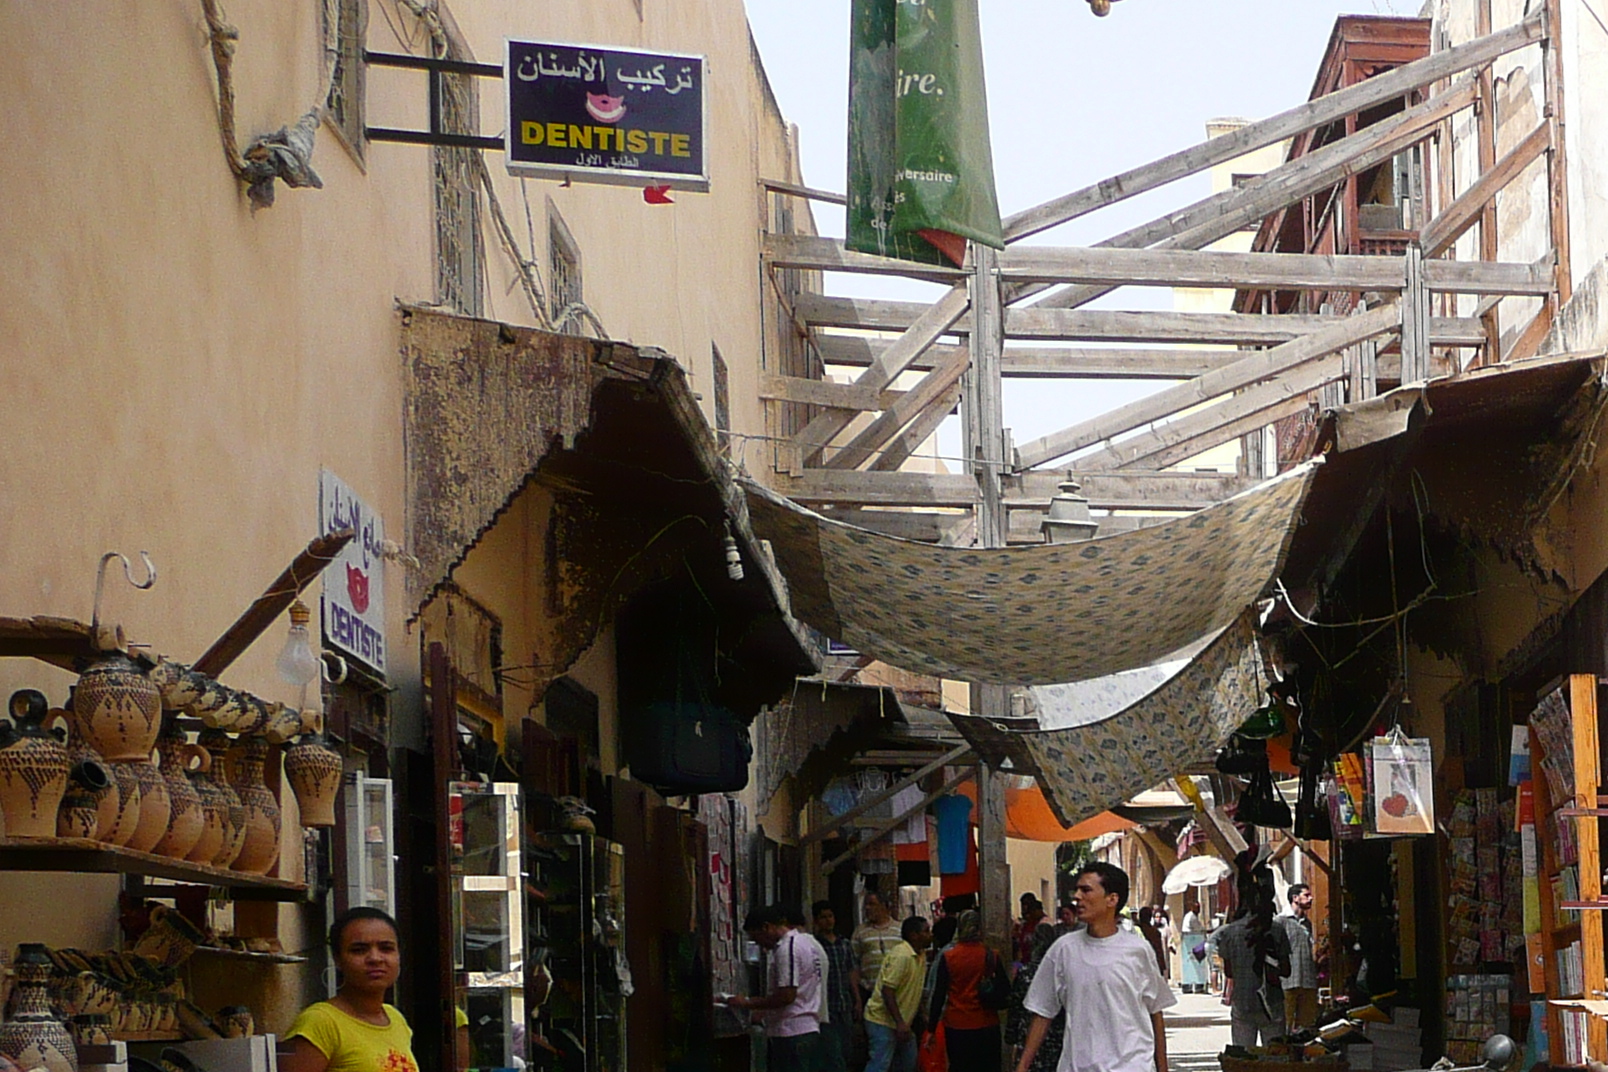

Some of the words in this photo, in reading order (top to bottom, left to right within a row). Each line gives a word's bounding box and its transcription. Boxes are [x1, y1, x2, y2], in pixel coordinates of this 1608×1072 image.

[617, 64, 693, 94] تركيب
[521, 120, 691, 158] DENTISTE
[331, 601, 384, 667] DENTISTE
